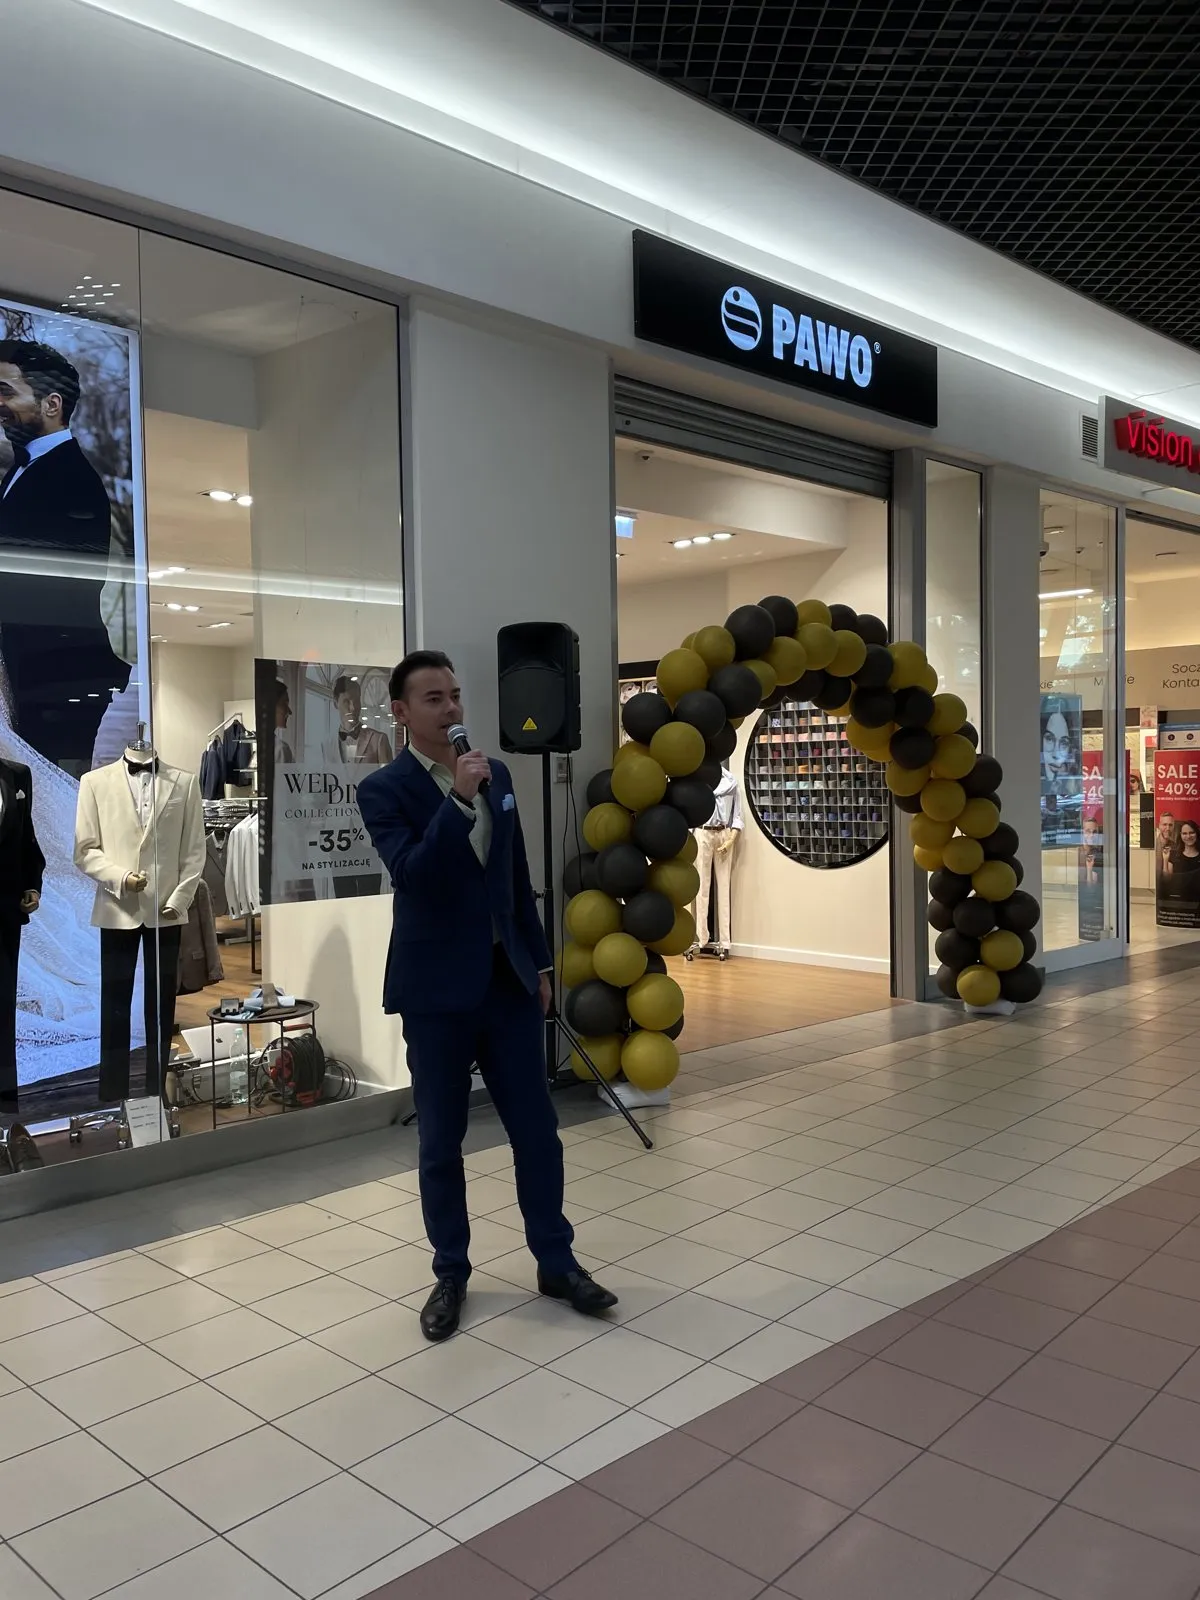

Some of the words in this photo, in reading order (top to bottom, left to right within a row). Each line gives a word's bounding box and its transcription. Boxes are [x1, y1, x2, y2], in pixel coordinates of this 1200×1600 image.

[772, 303, 872, 388] PAWO
[1115, 409, 1192, 467] Vision
[1157, 764, 1198, 779] SALE
[284, 807, 361, 819] COLLECTION
[308, 827, 365, 852] -35%
[302, 862, 315, 870] NA
[317, 858, 371, 869] STYLIZACJĘ
